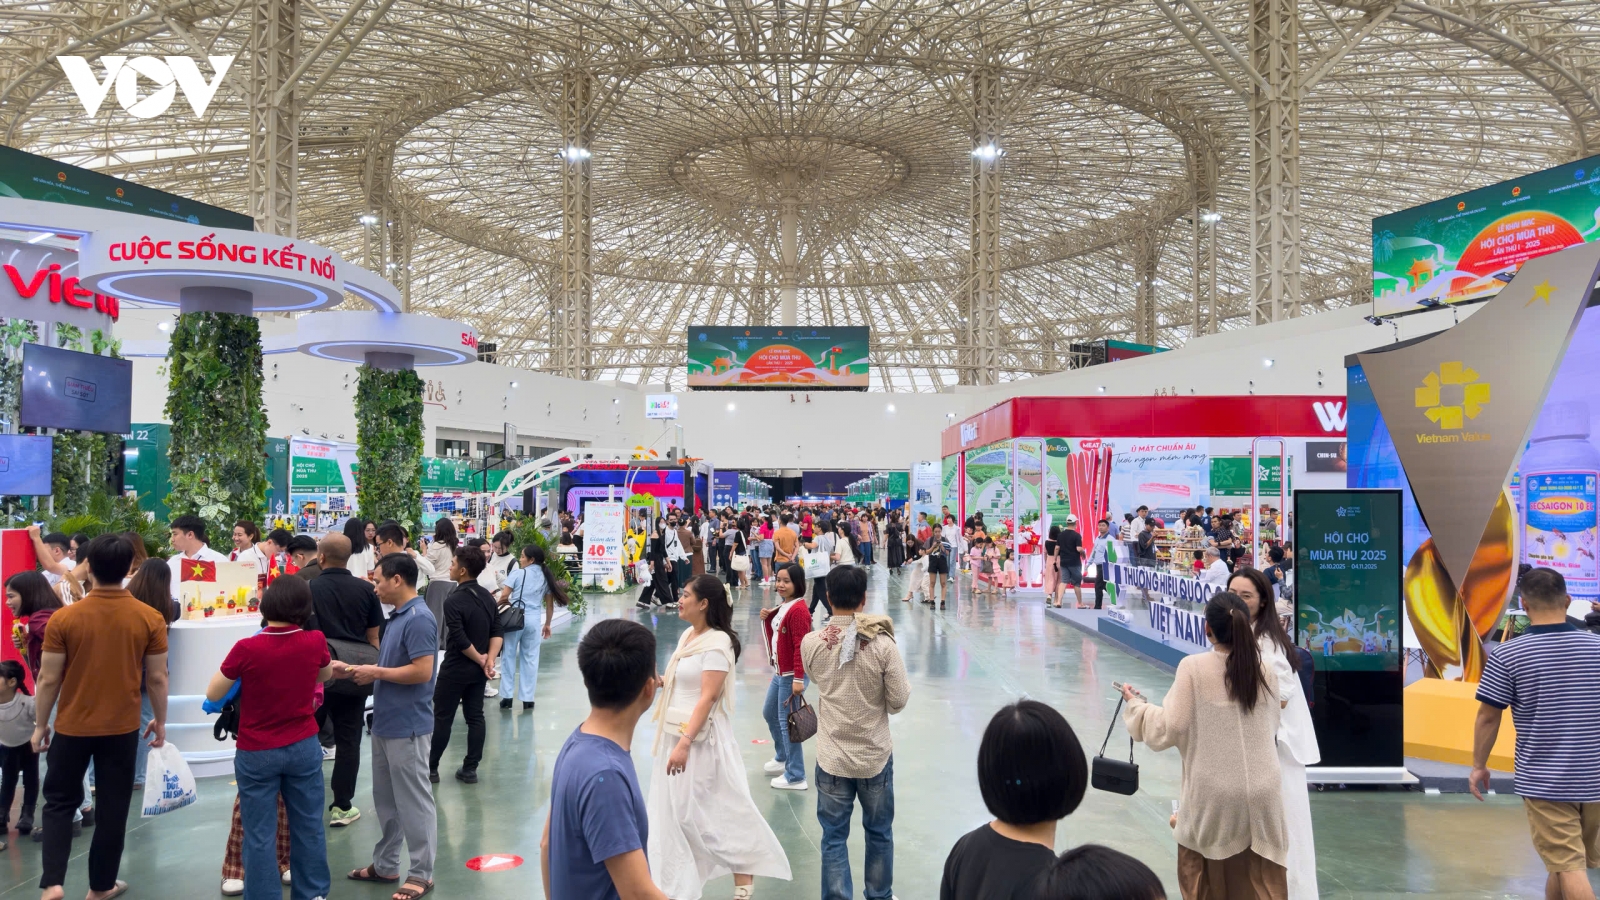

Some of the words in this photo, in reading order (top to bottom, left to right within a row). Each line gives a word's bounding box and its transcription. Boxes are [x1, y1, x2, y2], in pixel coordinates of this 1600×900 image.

[1498, 224, 1505, 233] LỄ
[1505, 221, 1520, 231] KHAI
[1521, 218, 1535, 228] MẠC
[1480, 239, 1495, 249] HỘI
[1497, 235, 1514, 245] CHỢ
[1516, 229, 1536, 241] MÙA
[1537, 225, 1555, 236] THU
[109, 236, 172, 264] CUỘC
[178, 233, 256, 263] SỐNG
[262, 243, 306, 271] KẾT
[1493, 247, 1504, 256] LẦN
[1505, 243, 1517, 254] THỨ
[1525, 240, 1540, 249] 2025
[136, 431, 149, 440] 22
[1416, 434, 1459, 443] Vietnam
[1138, 444, 1155, 452] MÁT
[1156, 443, 1184, 451] CHUẨN
[1134, 456, 1156, 468] ngon
[1576, 502, 1584, 510] 10
[1586, 502, 1594, 510] EC
[1324, 531, 1343, 544] HỘI
[1346, 532, 1369, 544] CHỢ
[588, 544, 605, 556] 40
[1310, 549, 1334, 561] MÙA
[1337, 550, 1357, 560] THU
[1360, 550, 1387, 560] 2025
[1124, 567, 1158, 592] THƯƠNG
[1160, 575, 1178, 601] HIỆU
[1149, 597, 1171, 640] VIỆT
[1175, 609, 1207, 648] NAM
